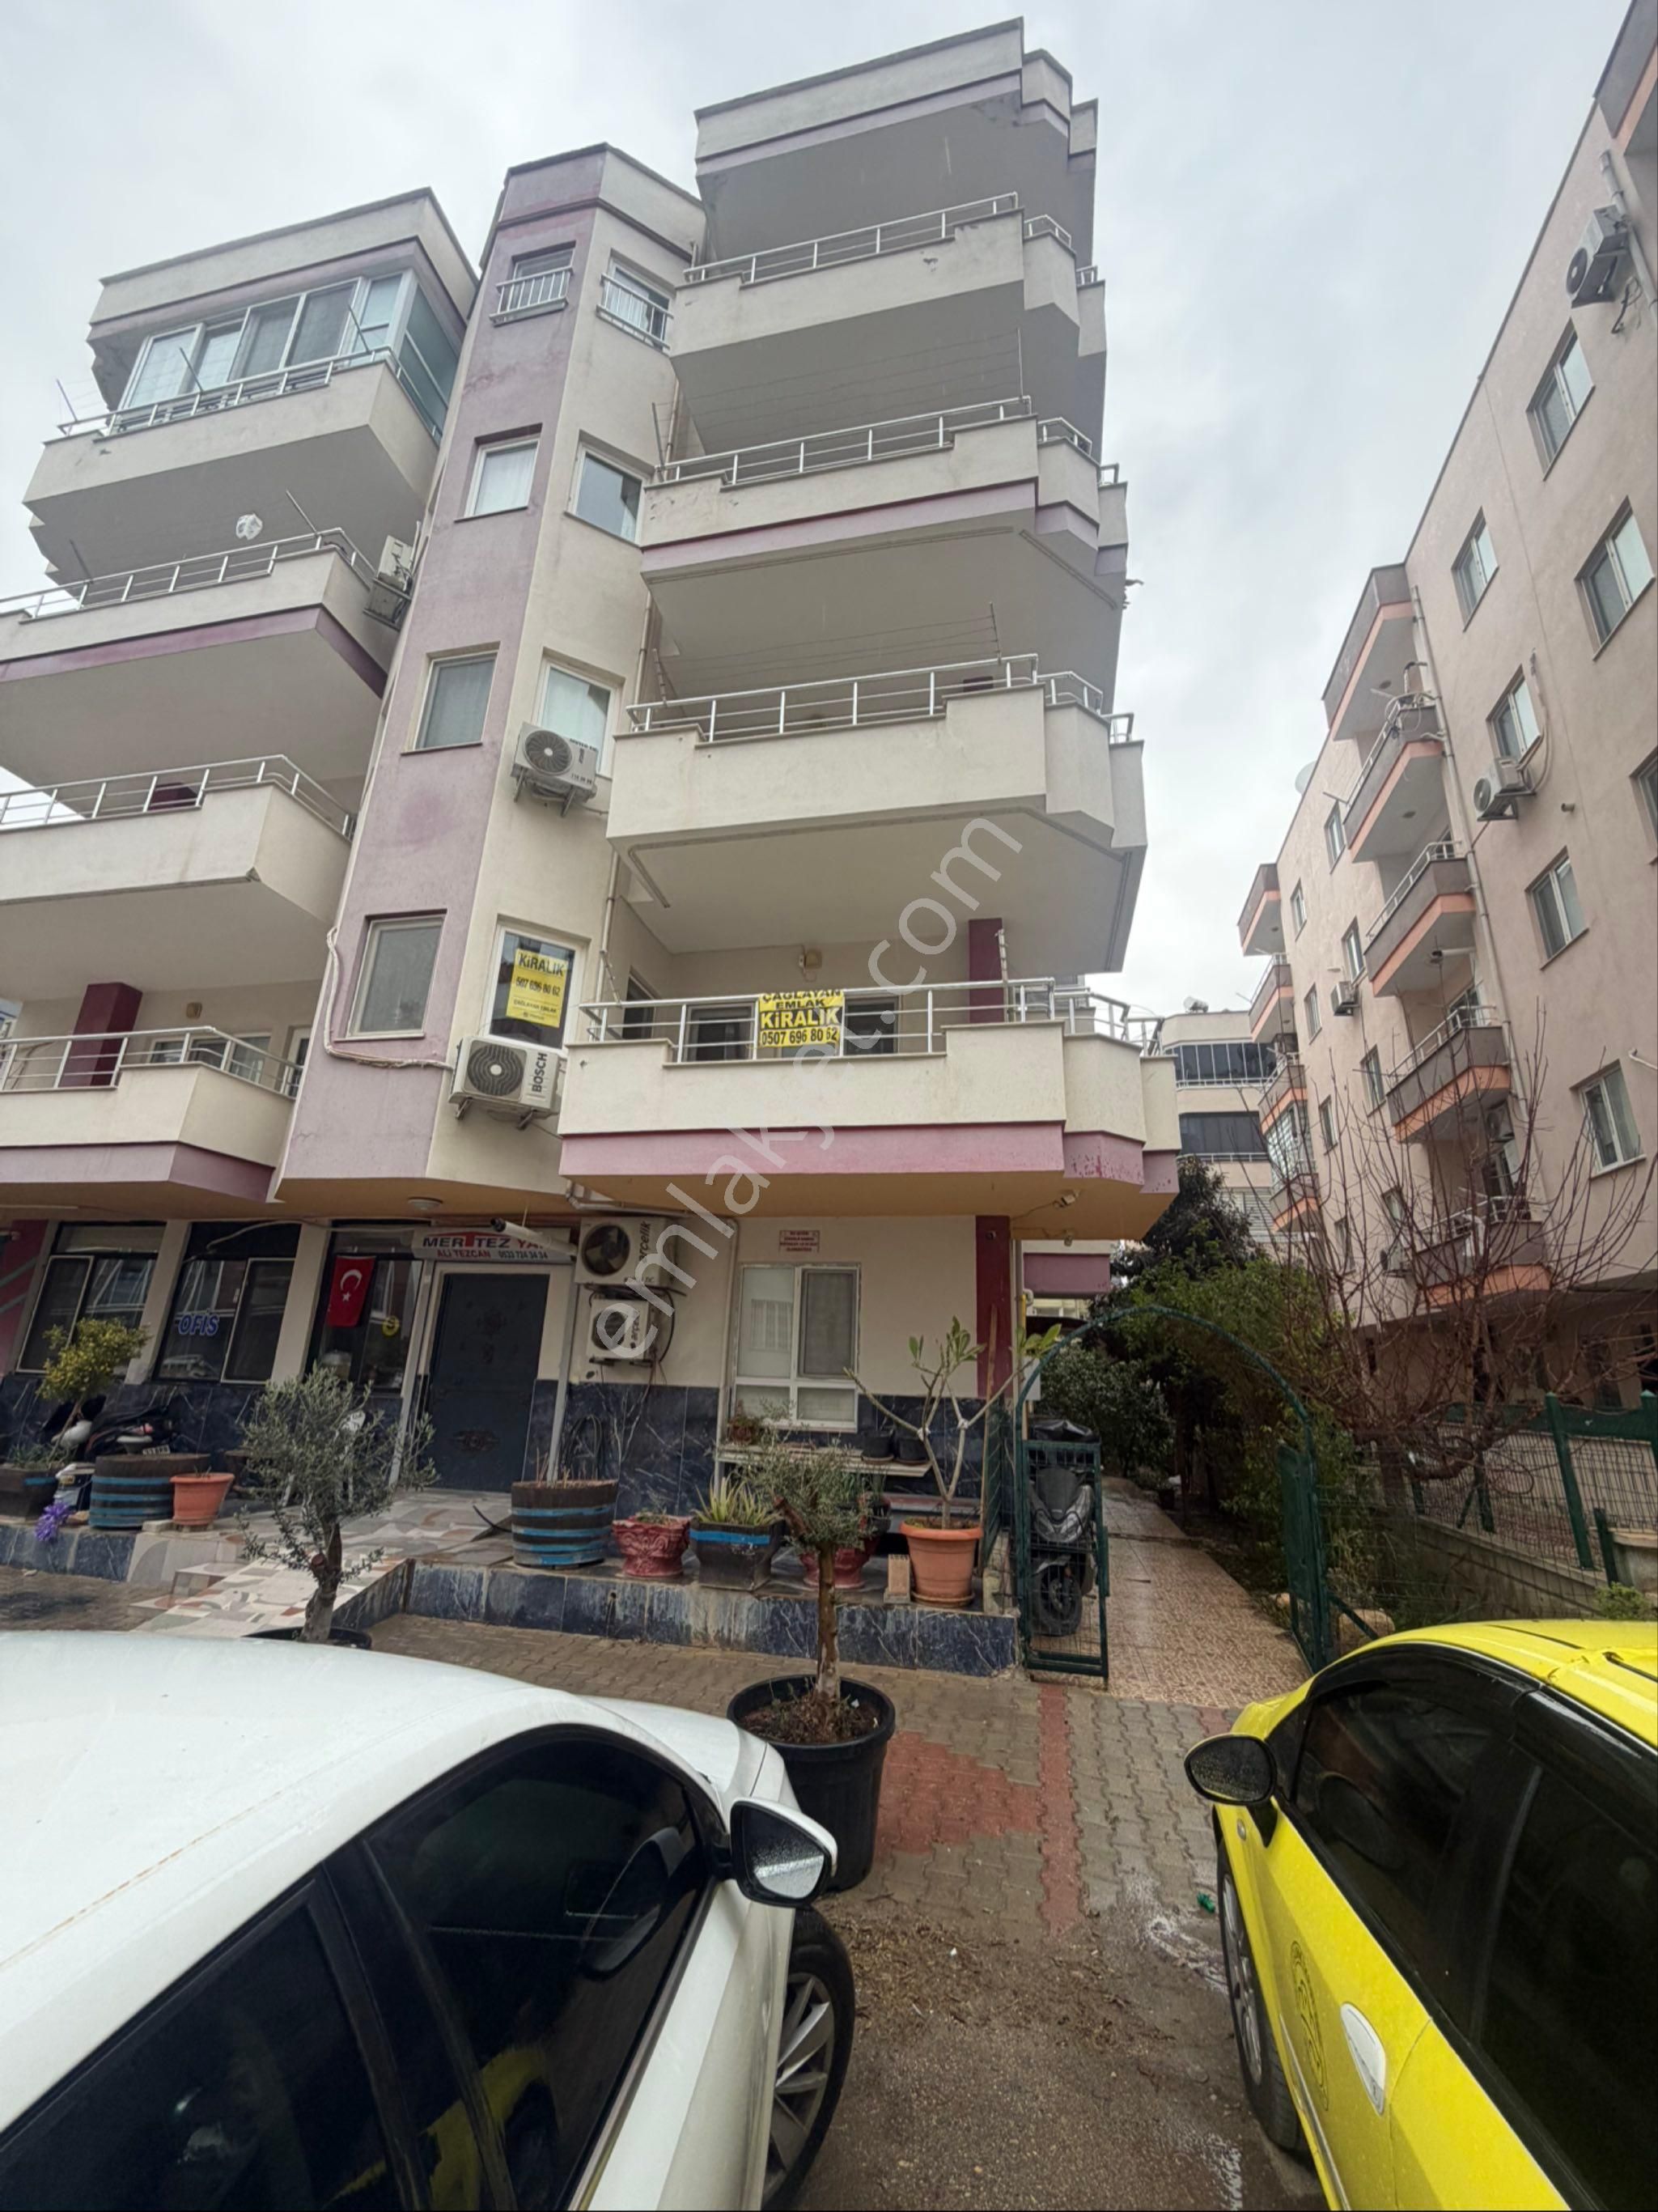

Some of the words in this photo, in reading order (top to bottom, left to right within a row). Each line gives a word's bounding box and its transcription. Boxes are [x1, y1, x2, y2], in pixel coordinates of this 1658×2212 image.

[775, 999, 825, 1009] EMLAK
[761, 1031, 786, 1044] 0507
[790, 1030, 808, 1043] 696
[810, 1029, 823, 1042] 80
[826, 1027, 838, 1041] 62
[532, 1052, 548, 1093] BOSCH
